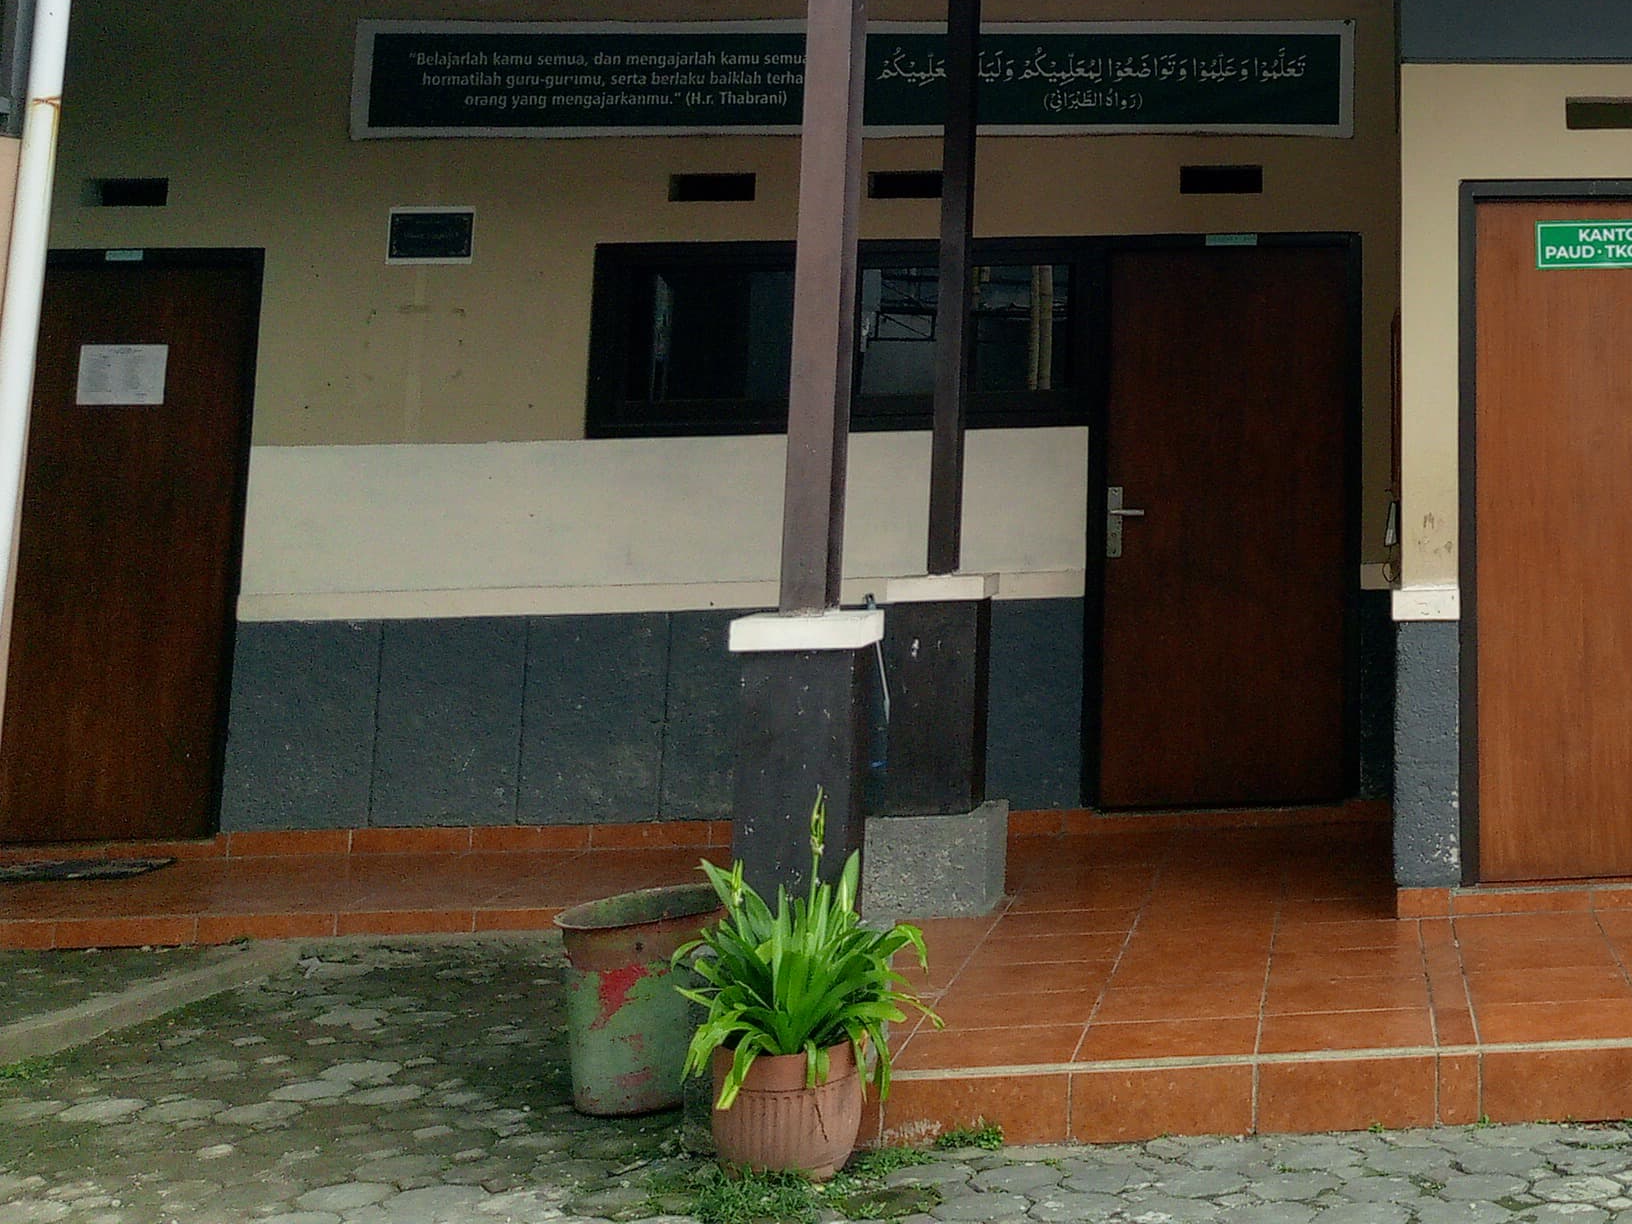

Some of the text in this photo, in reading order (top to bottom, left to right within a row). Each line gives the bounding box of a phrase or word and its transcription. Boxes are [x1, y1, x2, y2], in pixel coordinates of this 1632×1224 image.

[492, 51, 533, 65] kamu
[537, 53, 588, 67] semua,
[594, 51, 621, 65] dan
[626, 51, 715, 68] mengajarlah
[720, 51, 760, 65] kamu
[422, 71, 804, 88] hormatilah guru-gurumu, serta berlaku baiklah terha
[464, 94, 507, 108] orang
[511, 94, 547, 109] yang
[719, 91, 788, 107] Thabrani)
[1545, 245, 1595, 259] PAUD
